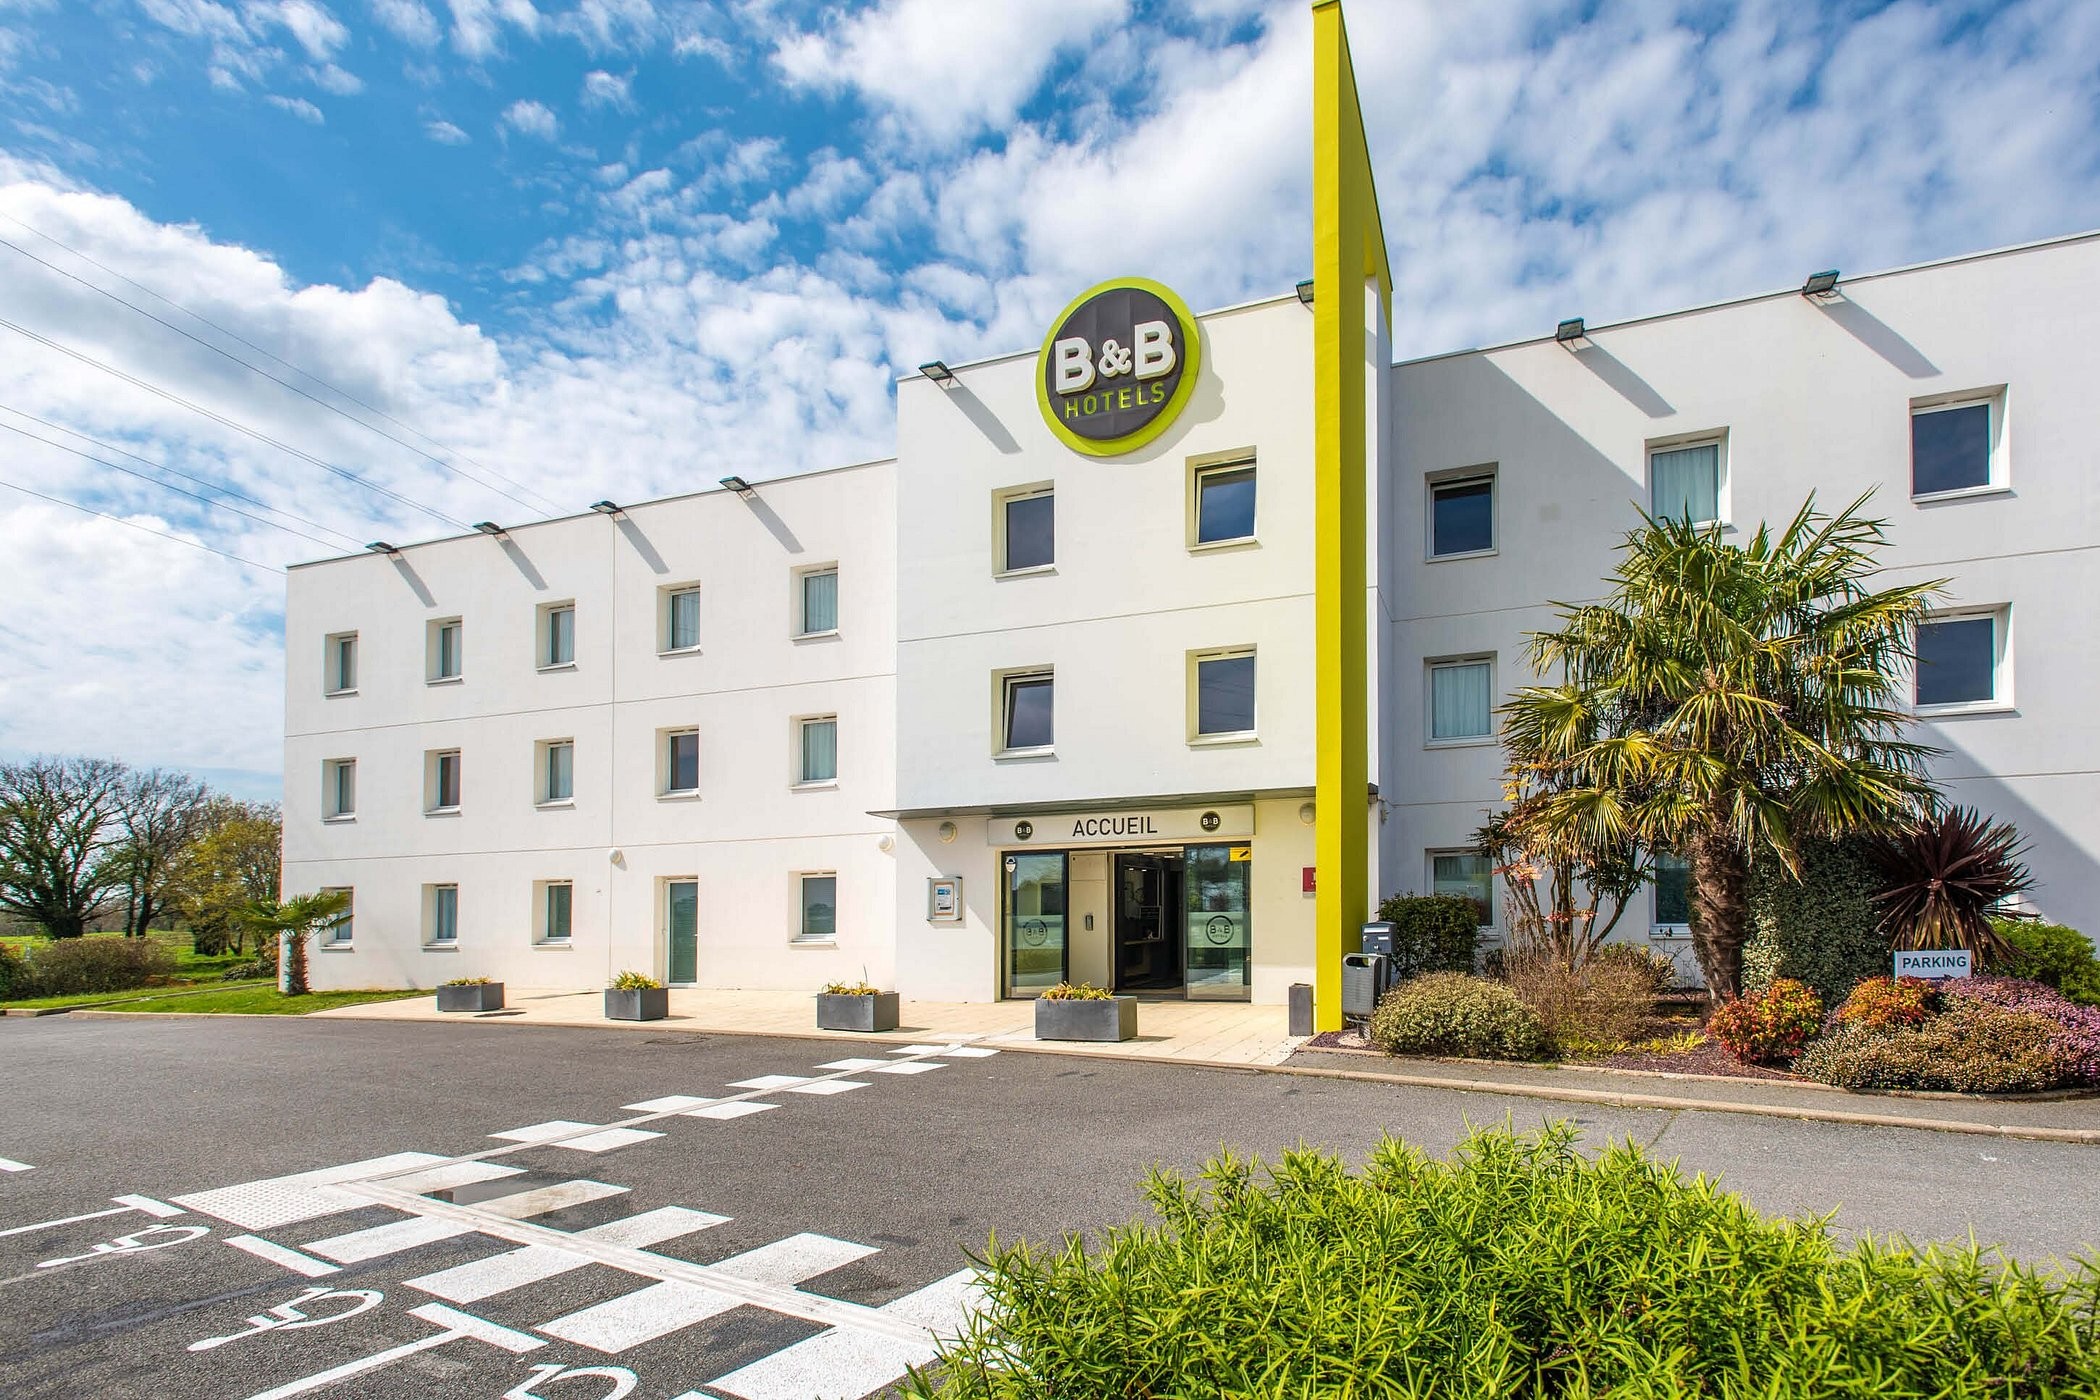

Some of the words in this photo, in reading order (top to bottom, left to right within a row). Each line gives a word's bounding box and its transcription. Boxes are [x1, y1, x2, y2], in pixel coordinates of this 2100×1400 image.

[1055, 320, 1176, 394] B&B
[1065, 381, 1165, 419] HOTELS
[1072, 816, 1158, 837] ACCUEIL
[1902, 956, 1967, 968] PARKING
